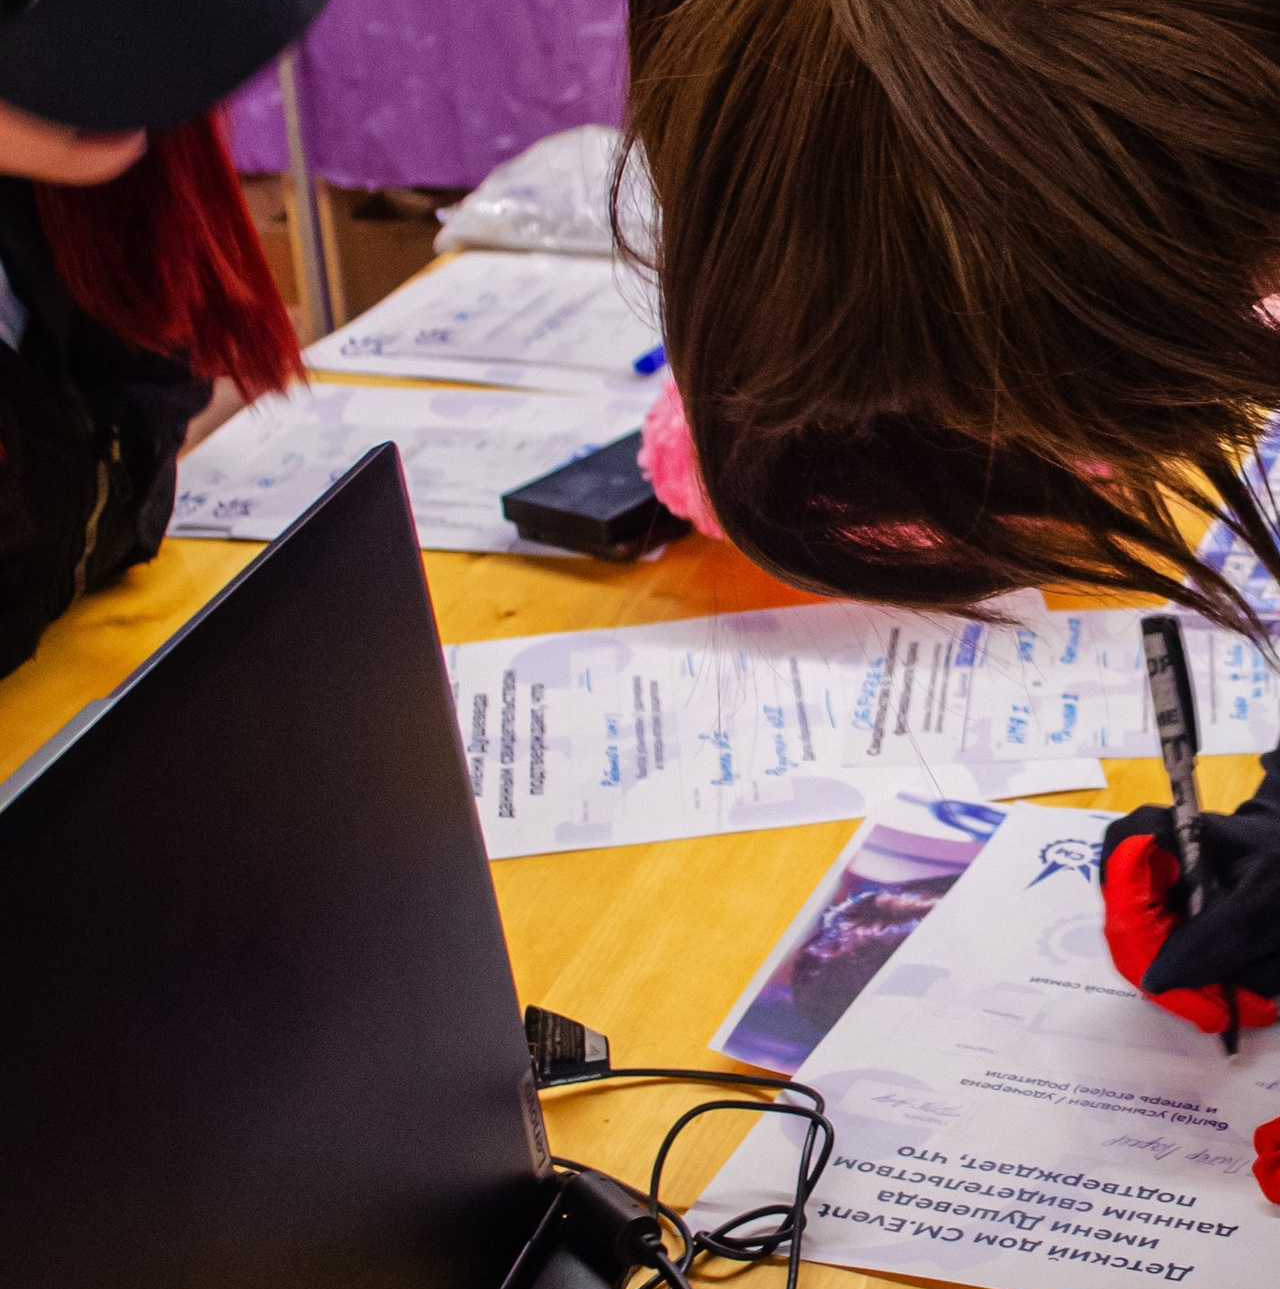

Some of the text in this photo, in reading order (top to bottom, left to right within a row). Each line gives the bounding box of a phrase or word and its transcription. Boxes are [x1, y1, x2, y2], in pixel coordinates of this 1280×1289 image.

[959, 1078, 1056, 1103] удочерена
[985, 1069, 1071, 1093] родители
[1073, 1083, 1136, 1103] его(ее)
[1069, 1096, 1168, 1119] усыновлен
[1139, 1094, 1202, 1115] теперь
[1171, 1111, 1229, 1131] был(а)
[895, 1144, 1198, 1209] подтверждает, что
[832, 1154, 1240, 1239] данным свидетельством
[876, 1189, 1162, 1250] имени Душеведа
[974, 1231, 1043, 1253] дом
[1047, 1244, 1195, 1283] Детский
